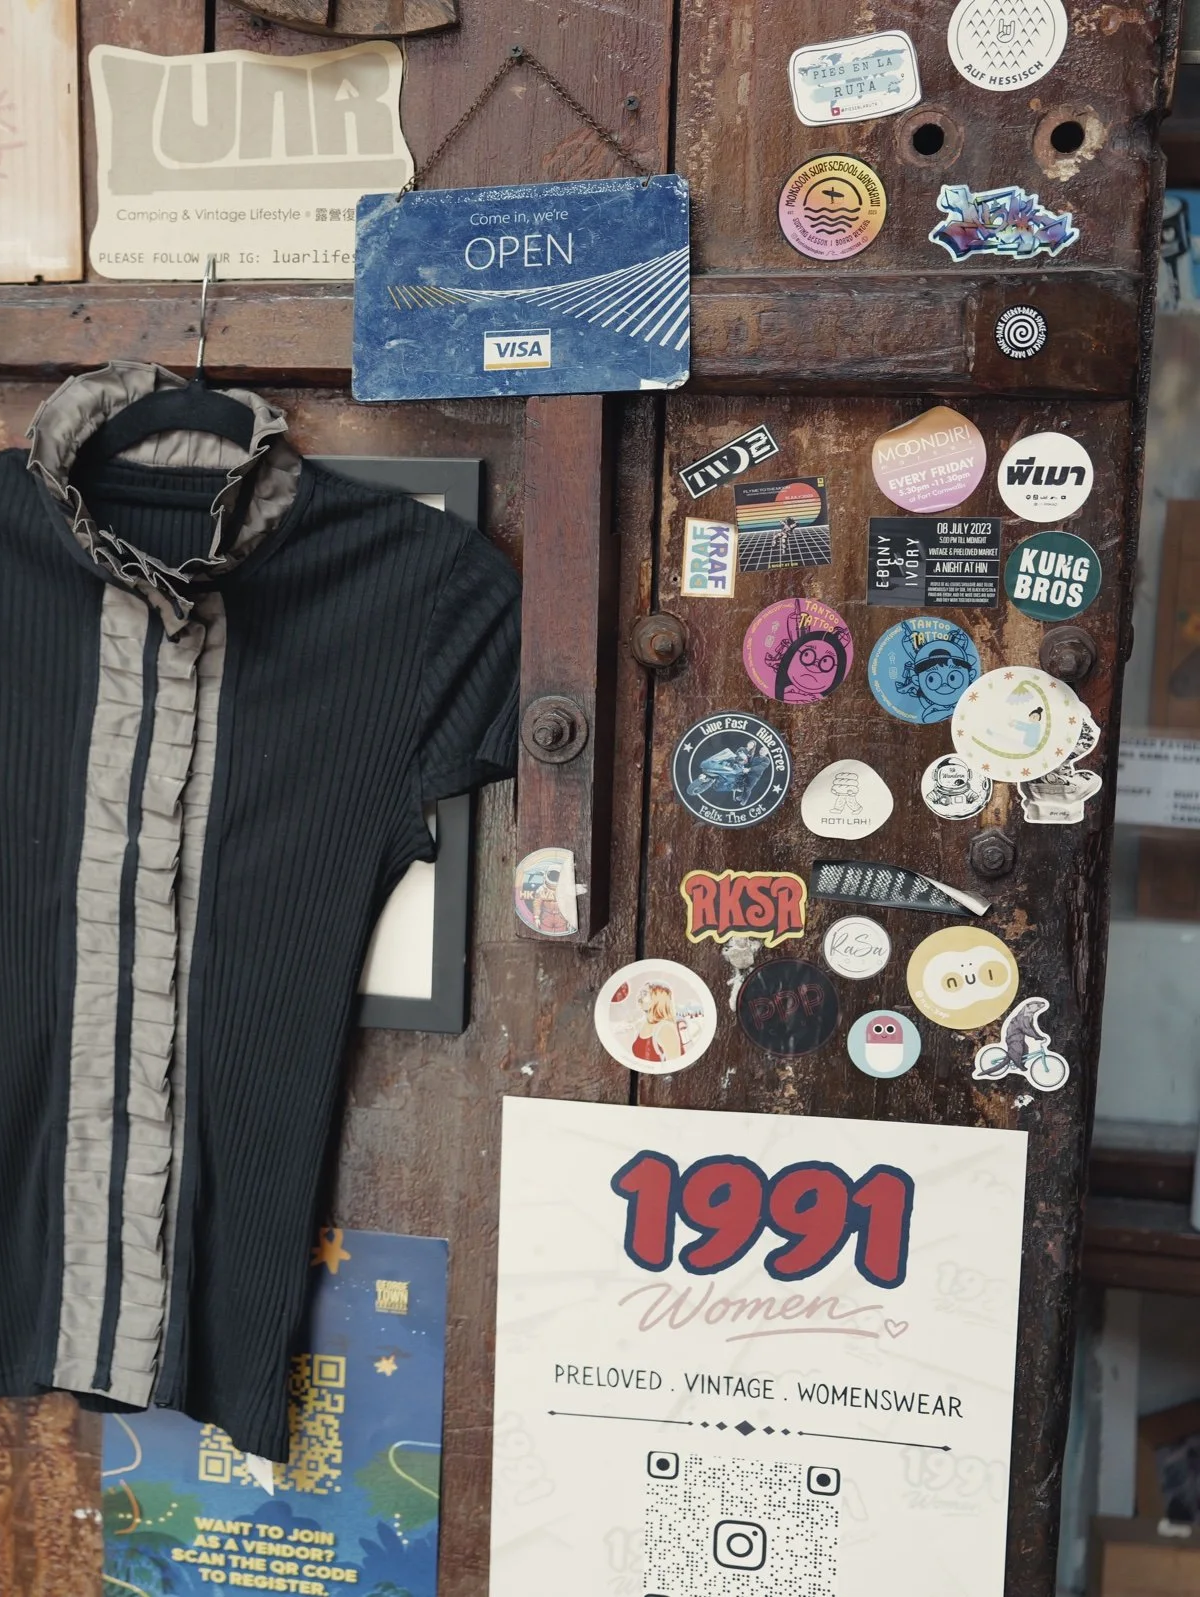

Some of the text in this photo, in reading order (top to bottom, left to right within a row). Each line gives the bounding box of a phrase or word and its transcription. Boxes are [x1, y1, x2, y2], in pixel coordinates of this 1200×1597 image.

[813, 57, 893, 79] PIES EN LA
[964, 60, 1044, 86] AUF HESSISCH
[834, 81, 876, 97] RUTA
[785, 160, 881, 207] MONSOON SURFSCHOOL LANGKAWI
[116, 207, 301, 222] Camping & Vintage Lifestyle
[470, 210, 568, 226] Come in, we're
[99, 253, 144, 263] PLEASE
[153, 253, 199, 263] FOLLOW
[239, 253, 261, 263] IG:
[464, 232, 573, 270] OPEN
[493, 340, 542, 358] VISA
[878, 424, 970, 464] MOONDIRI
[888, 457, 974, 490] EVERY FRIDAY
[937, 523, 992, 535] 08 JULY 2023
[707, 526, 730, 590] KRAF
[876, 535, 891, 588] EBONY
[905, 538, 919, 586] IVORY
[929, 548, 948, 556] VINTAGE
[953, 548, 978, 556] PRELOVED
[978, 548, 998, 556] MARKET
[1019, 548, 1090, 582] KUNG
[942, 562, 963, 573] NIGHT
[964, 562, 974, 573] AT
[975, 562, 988, 573] HIN
[1013, 573, 1084, 608] BROS
[798, 613, 834, 632] TATTOO
[805, 600, 839, 625] TANTOO
[909, 619, 951, 631] TANTOO
[910, 631, 950, 650] TATTOO
[700, 717, 786, 771] Live Fast Ride Free
[699, 804, 767, 823] Felix The Cat
[830, 931, 888, 957] RaSa
[610, 1149, 915, 1289] 1991
[377, 1290, 409, 1304] TOWN
[618, 1281, 884, 1332] Women
[554, 1364, 964, 1419] PRELOVED VINTAGE WOMENSWEAR
[193, 1516, 334, 1546] WANT TO JOIN
[192, 1533, 335, 1563] AS A VENDOR?
[171, 1548, 357, 1583] SCAN THE QR CODE
[198, 1566, 330, 1597] TO REGISTER.
